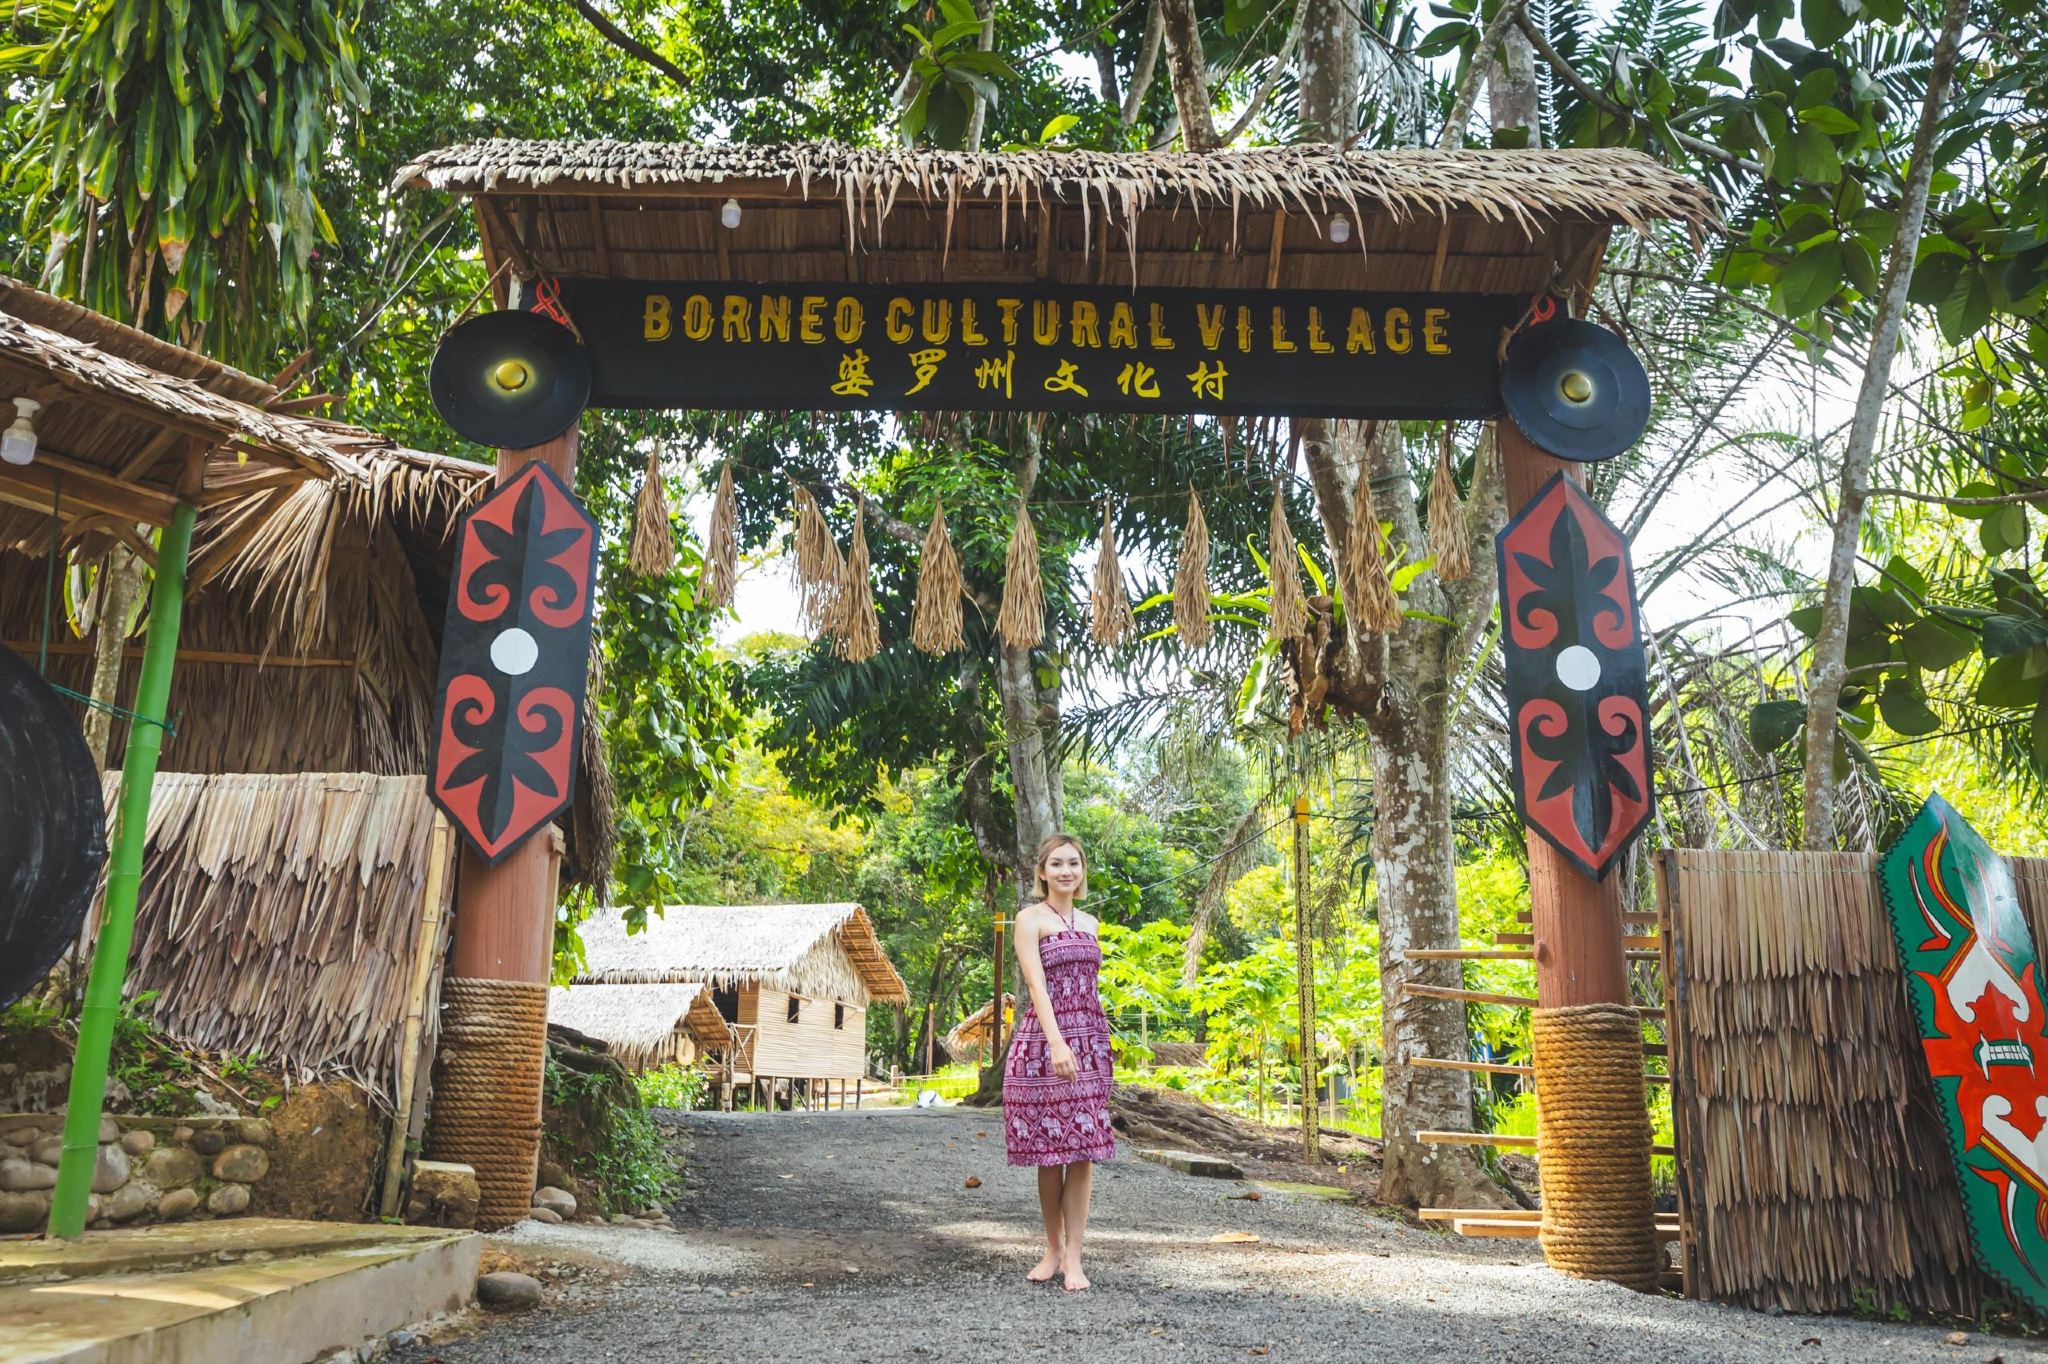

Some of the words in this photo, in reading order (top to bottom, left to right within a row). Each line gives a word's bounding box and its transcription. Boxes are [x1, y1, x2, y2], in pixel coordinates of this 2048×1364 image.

[643, 294, 866, 343] BORNEO
[885, 297, 1175, 350] CULTURAL
[1197, 303, 1452, 355] VILLAGE
